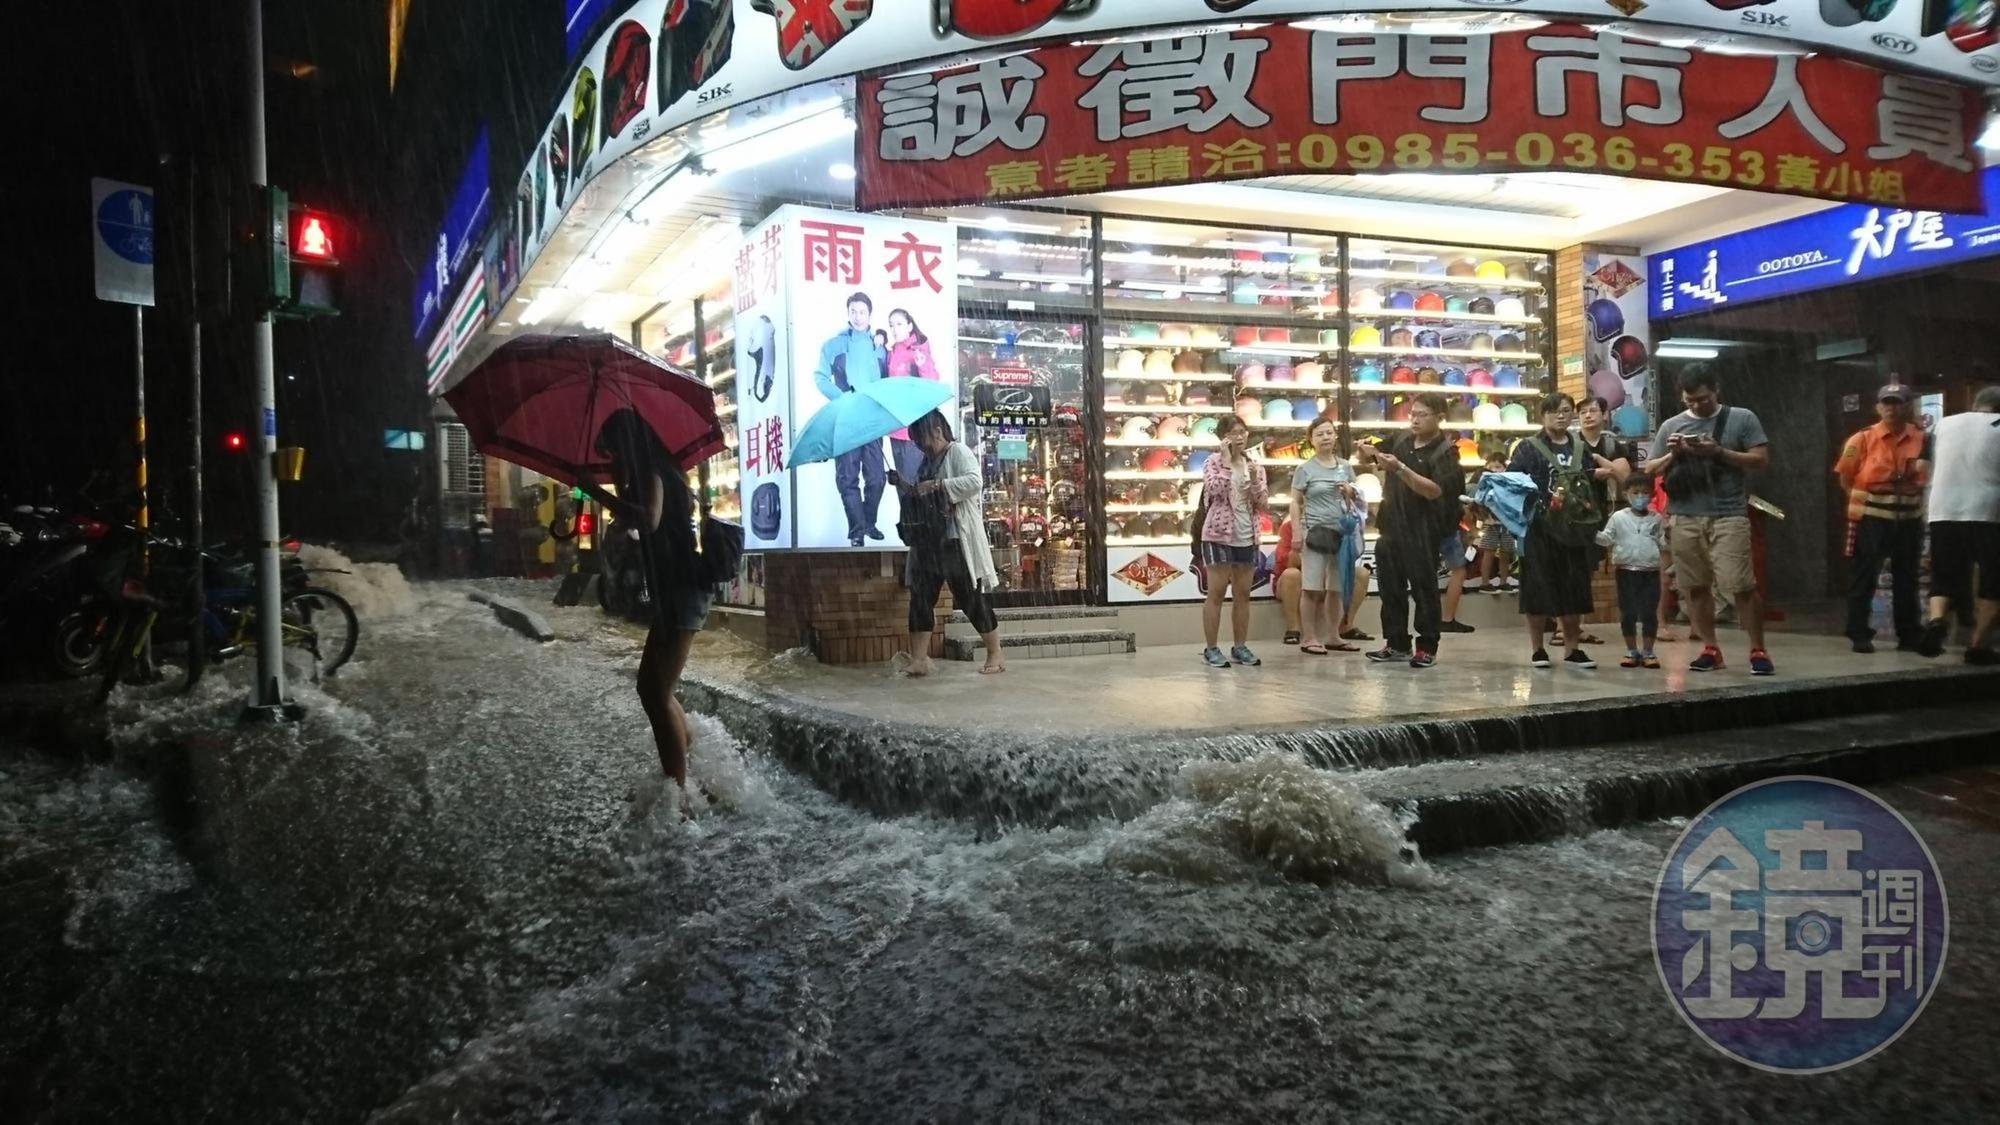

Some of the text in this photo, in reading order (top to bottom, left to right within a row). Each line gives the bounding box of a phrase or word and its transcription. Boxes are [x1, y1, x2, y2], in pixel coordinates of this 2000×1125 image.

[1741, 10, 1790, 27] SBK
[698, 83, 732, 103] SBK
[880, 32, 1974, 173] 誠徵門市人員
[800, 220, 943, 294] 雨衣
[993, 369, 1029, 381] Supreme
[745, 415, 783, 477] 耳機
